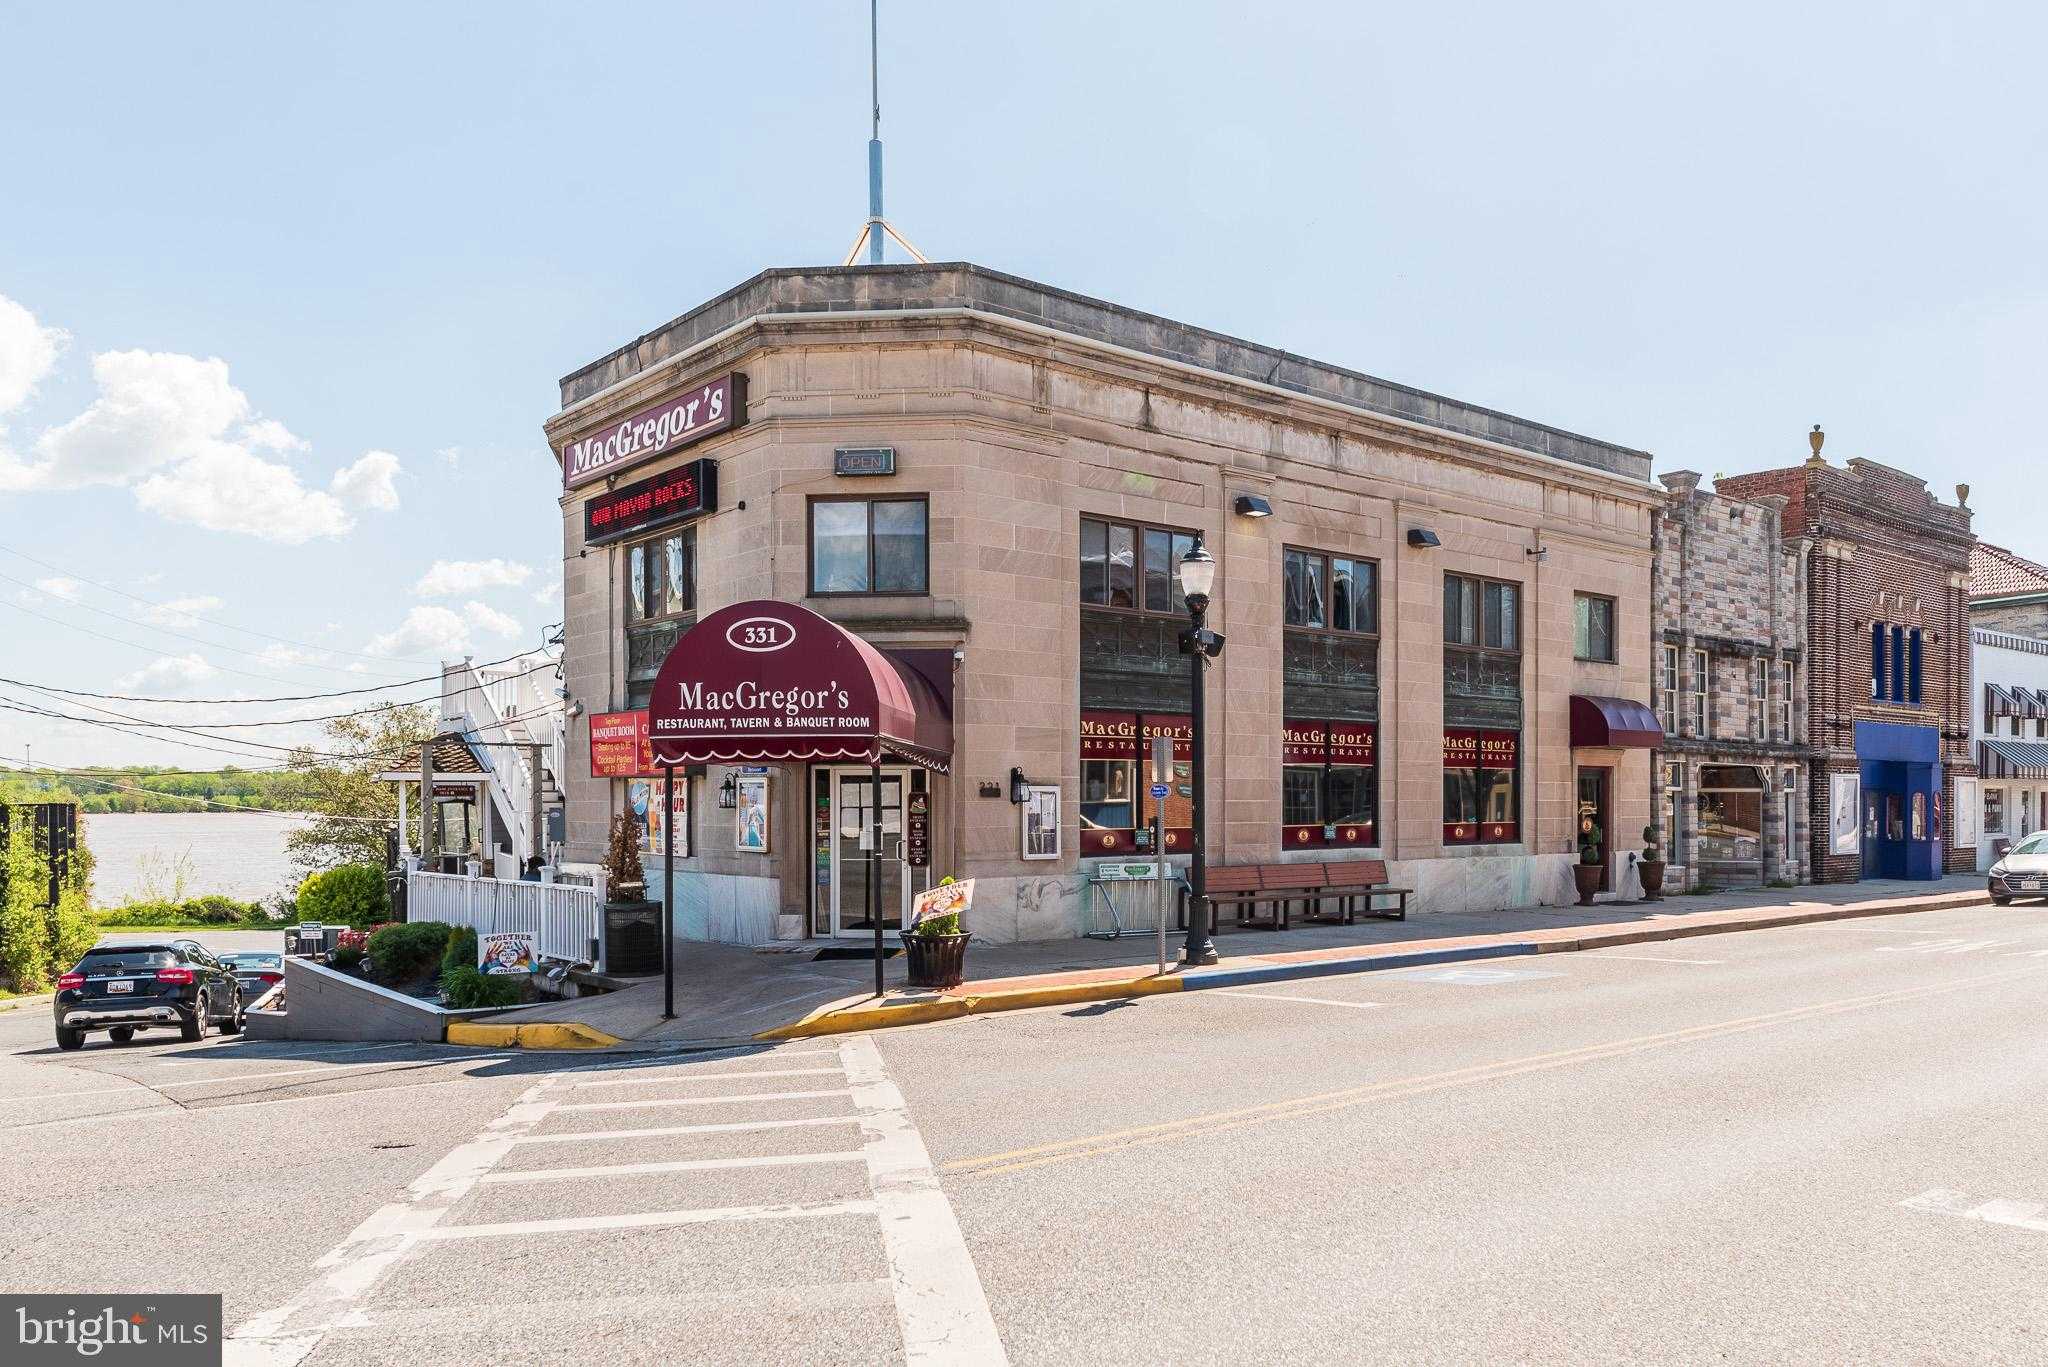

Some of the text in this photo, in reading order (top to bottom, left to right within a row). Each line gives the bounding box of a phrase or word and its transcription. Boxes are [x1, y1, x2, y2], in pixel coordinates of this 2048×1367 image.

[571, 386, 723, 475] MacGregor's
[744, 627, 778, 644] 331
[678, 680, 850, 716] MacGregor's
[656, 718, 727, 730] RESTAURANT,
[731, 718, 770, 729] TAVERN
[774, 717, 783, 728] &
[786, 717, 835, 728] BANQUET
[838, 716, 870, 728] ROOM
[1080, 720, 1193, 738] MacGregor's
[592, 726, 618, 740] BANQUET
[618, 724, 635, 737] ROOM
[1281, 729, 1373, 746] MacGregor's
[1083, 740, 1191, 751] RESTAUNT
[1440, 736, 1515, 751] MacGregor's
[1283, 747, 1370, 756] RESTAURANT
[1441, 752, 1513, 761] RESTAURANT
[484, 934, 533, 943] TOGETHER
